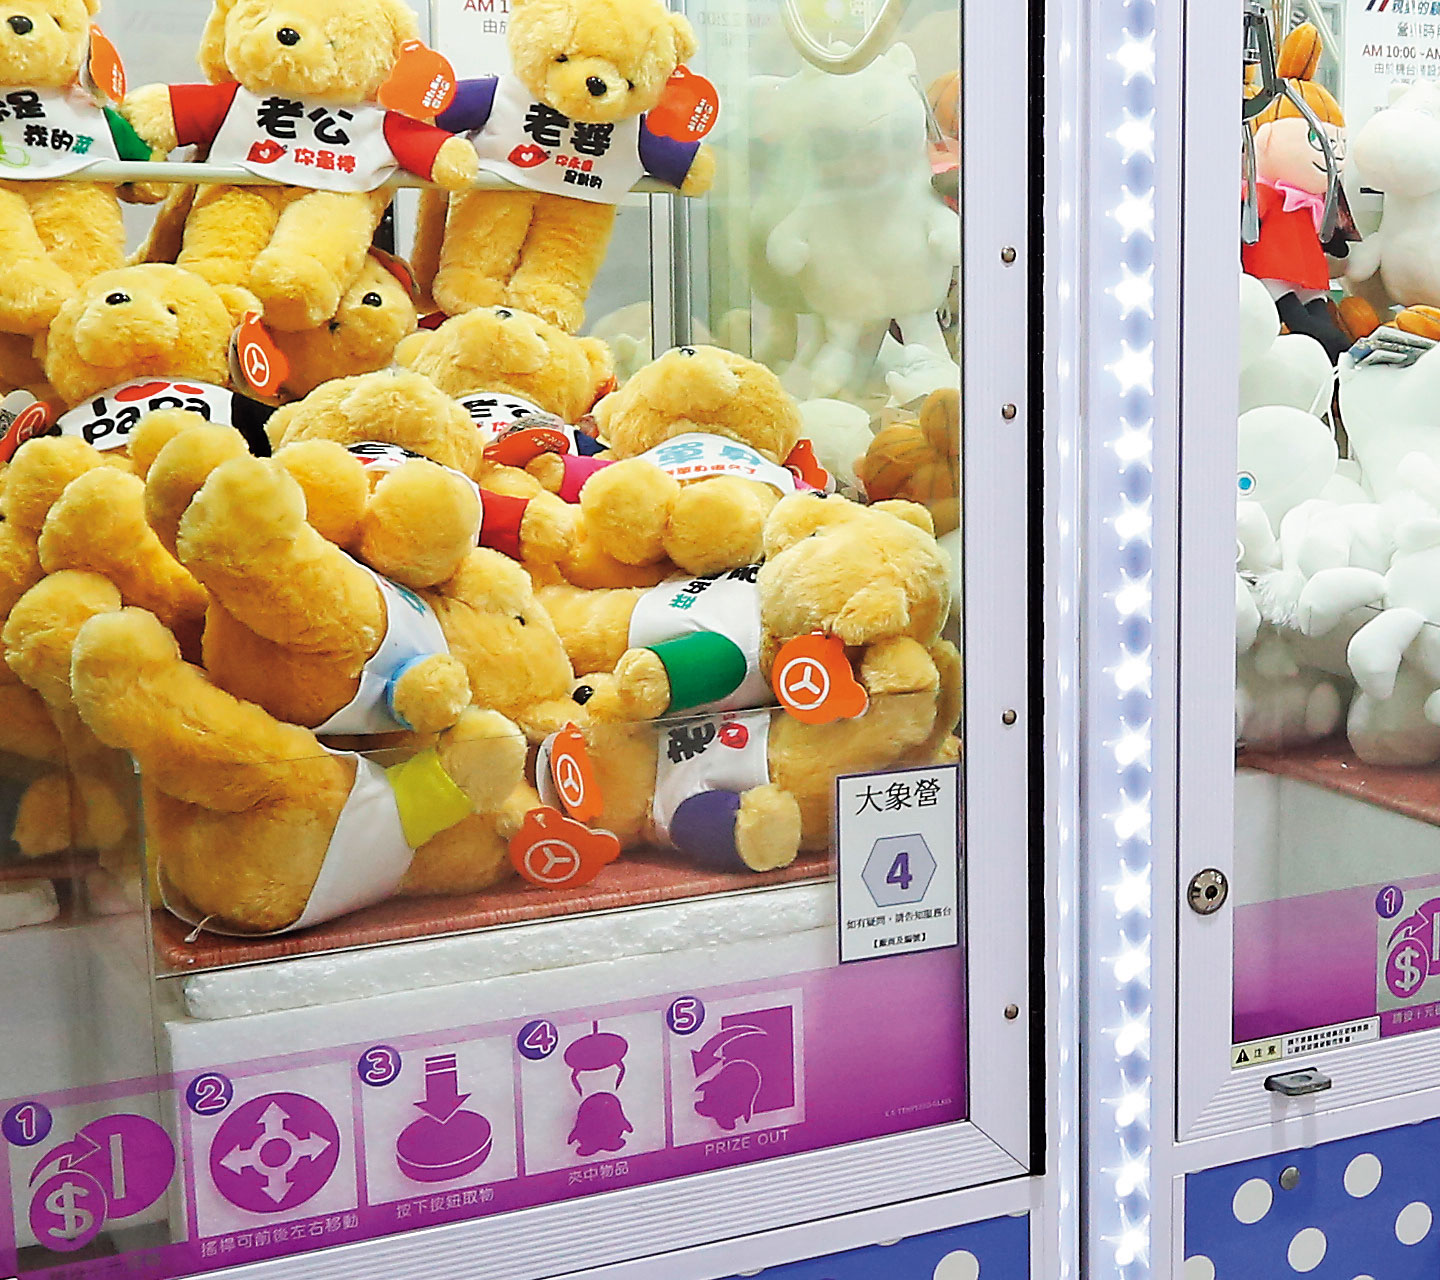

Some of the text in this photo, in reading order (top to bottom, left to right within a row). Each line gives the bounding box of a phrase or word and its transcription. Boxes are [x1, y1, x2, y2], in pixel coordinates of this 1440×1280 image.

[1362, 44, 1383, 57] AM
[257, 96, 353, 146] 老公
[524, 102, 614, 156] 老婆
[23, 124, 95, 154] 我的菜
[293, 148, 356, 174] 你最棒
[855, 778, 941, 816] 大象營
[886, 852, 913, 890] 4
[671, 1001, 697, 1027] 5
[524, 1021, 555, 1054] 4
[365, 1050, 395, 1083] 3
[195, 1077, 230, 1112] 2
[14, 1104, 40, 1140] 1
[703, 1129, 790, 1157] PRIZE OUT
[567, 1161, 630, 1187] 夾中物品
